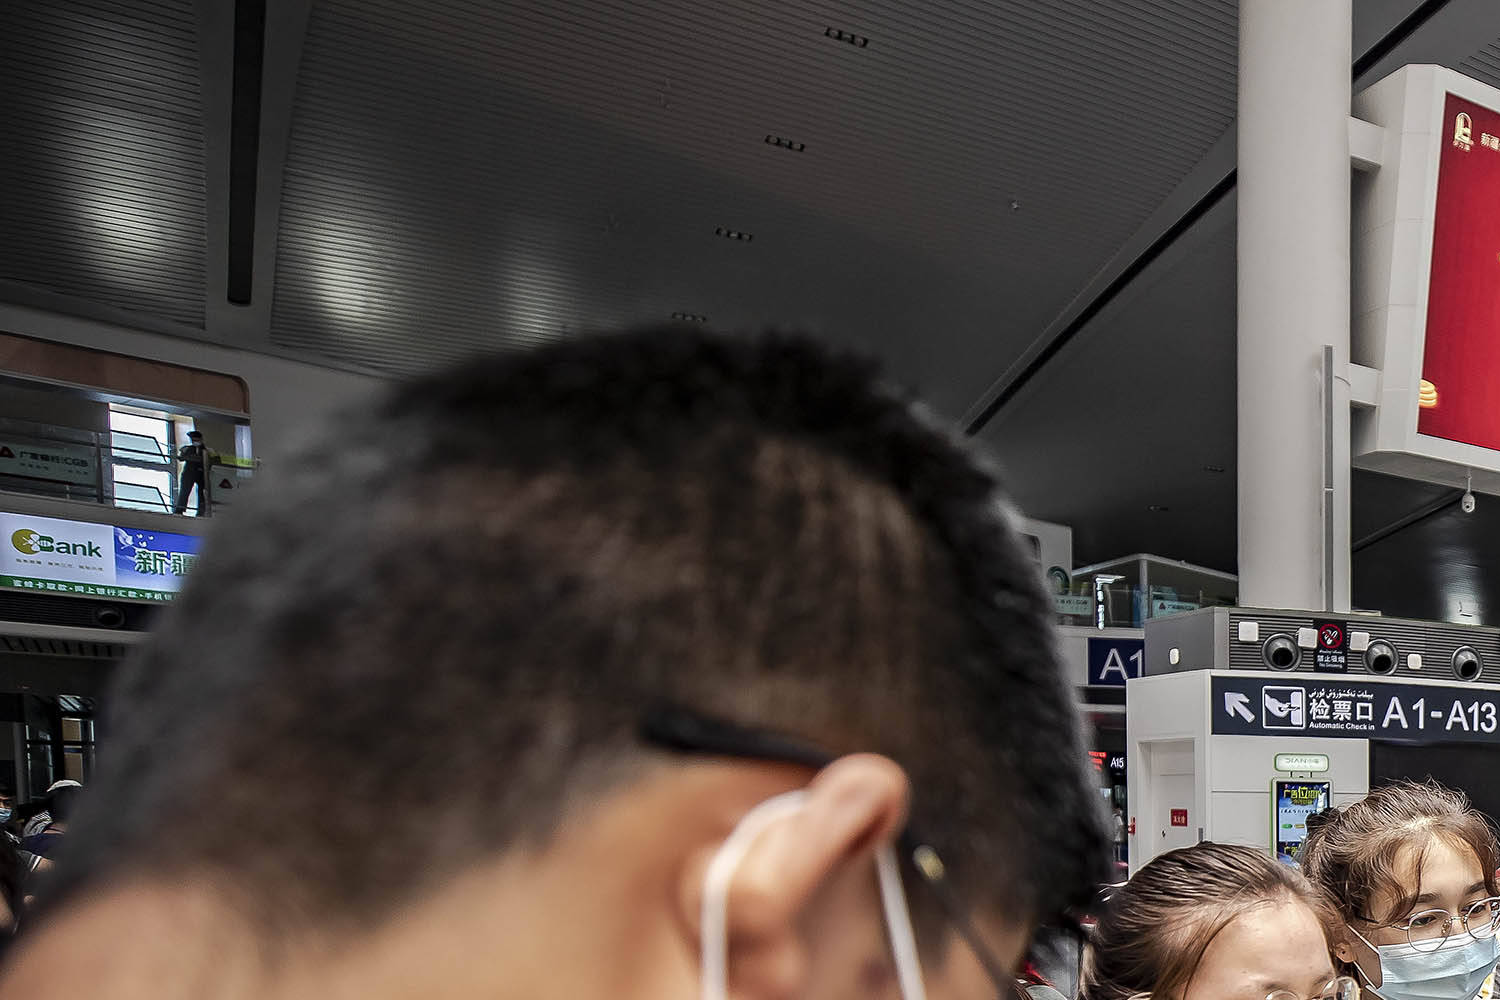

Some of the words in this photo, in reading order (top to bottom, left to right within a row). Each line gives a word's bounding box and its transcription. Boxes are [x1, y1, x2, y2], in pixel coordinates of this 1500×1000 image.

[1309, 699, 1374, 721] 检票口
[1309, 721, 1345, 730] Automatic
[1345, 722, 1367, 731] Check
[1367, 723, 1375, 731] in
[1110, 757, 1125, 769] A15
